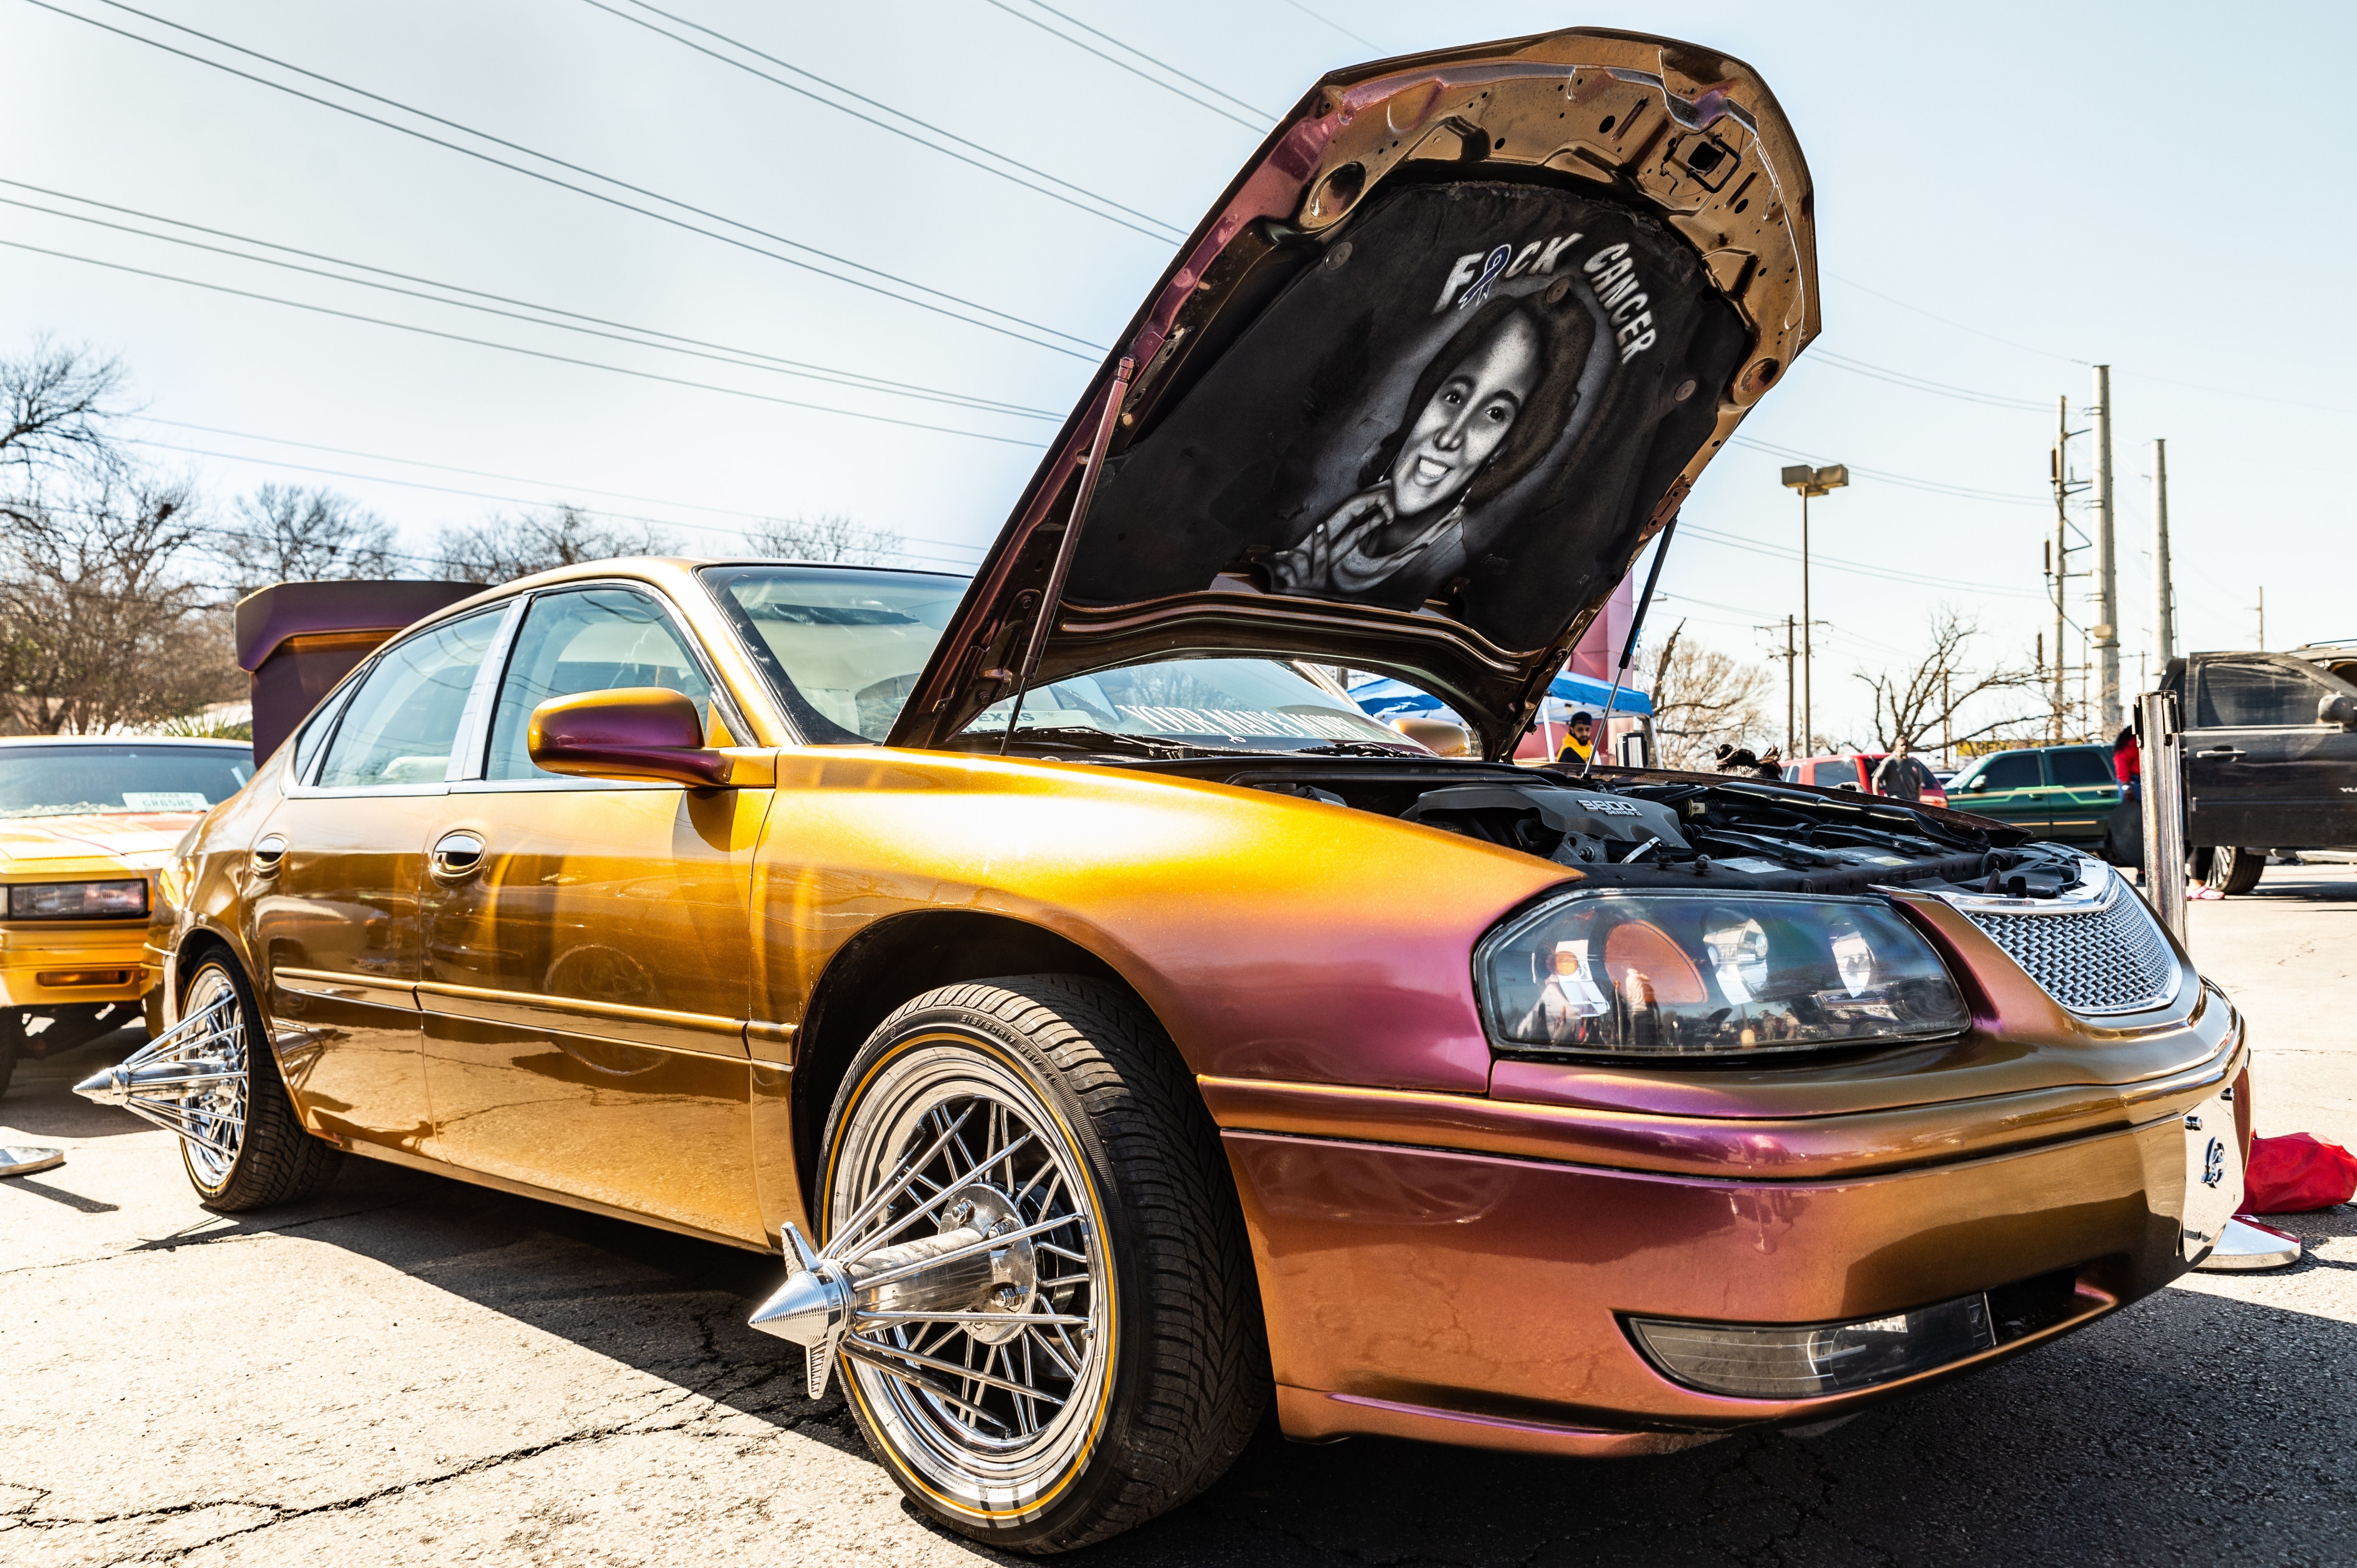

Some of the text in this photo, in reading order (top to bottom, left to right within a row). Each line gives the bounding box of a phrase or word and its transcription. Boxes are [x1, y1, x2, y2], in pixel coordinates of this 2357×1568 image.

[1583, 242, 1657, 365] CANCER
[978, 712, 1035, 722] EXAS
[1115, 705, 1246, 744] YOUR
[1277, 712, 1376, 742] MONEY
[1577, 800, 1637, 811] 3800
